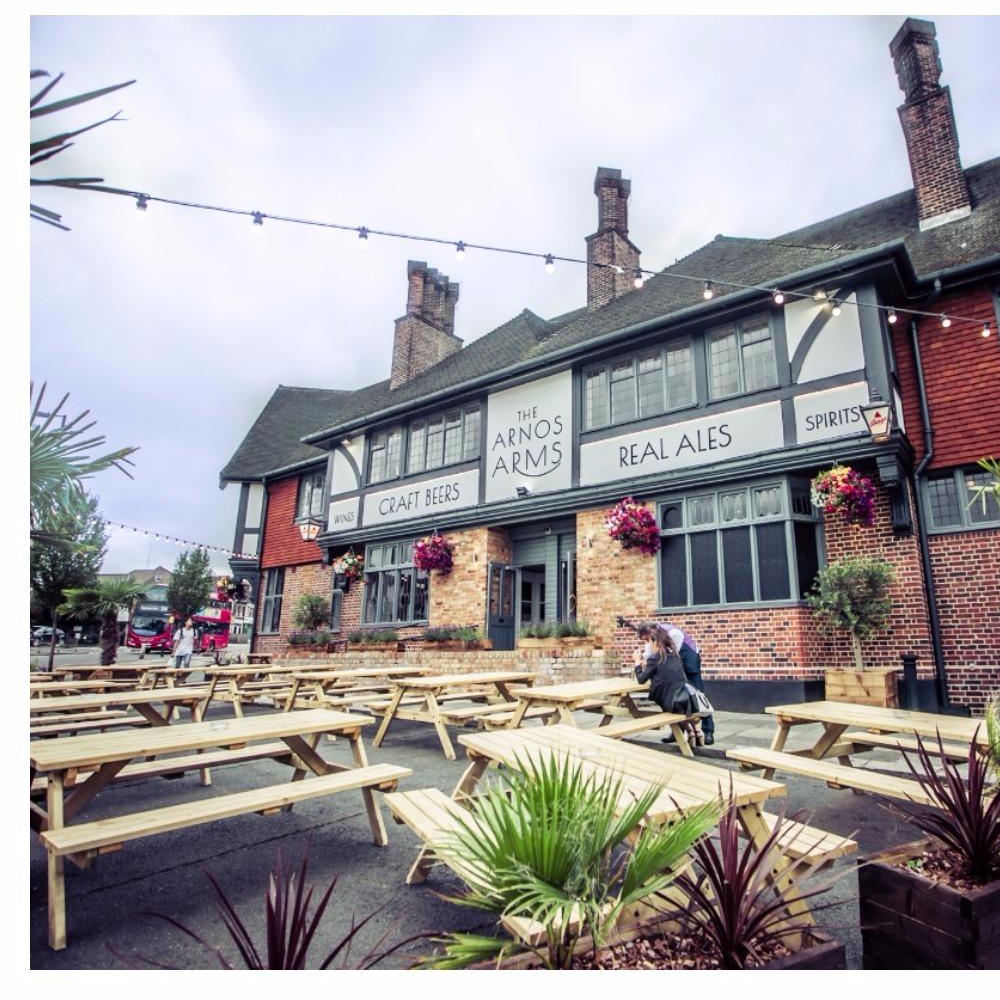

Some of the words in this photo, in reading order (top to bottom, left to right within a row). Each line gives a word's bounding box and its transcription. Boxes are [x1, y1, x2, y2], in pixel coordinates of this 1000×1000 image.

[516, 406, 538, 423] THE
[805, 406, 861, 432] SPIRITS
[491, 415, 563, 451] ARNOS
[618, 435, 669, 468] REAL
[675, 423, 733, 457] ALES
[491, 441, 563, 477] ARMS
[378, 491, 421, 516] CRAFT
[425, 482, 460, 507] BEERS
[333, 511, 355, 525] WINES
